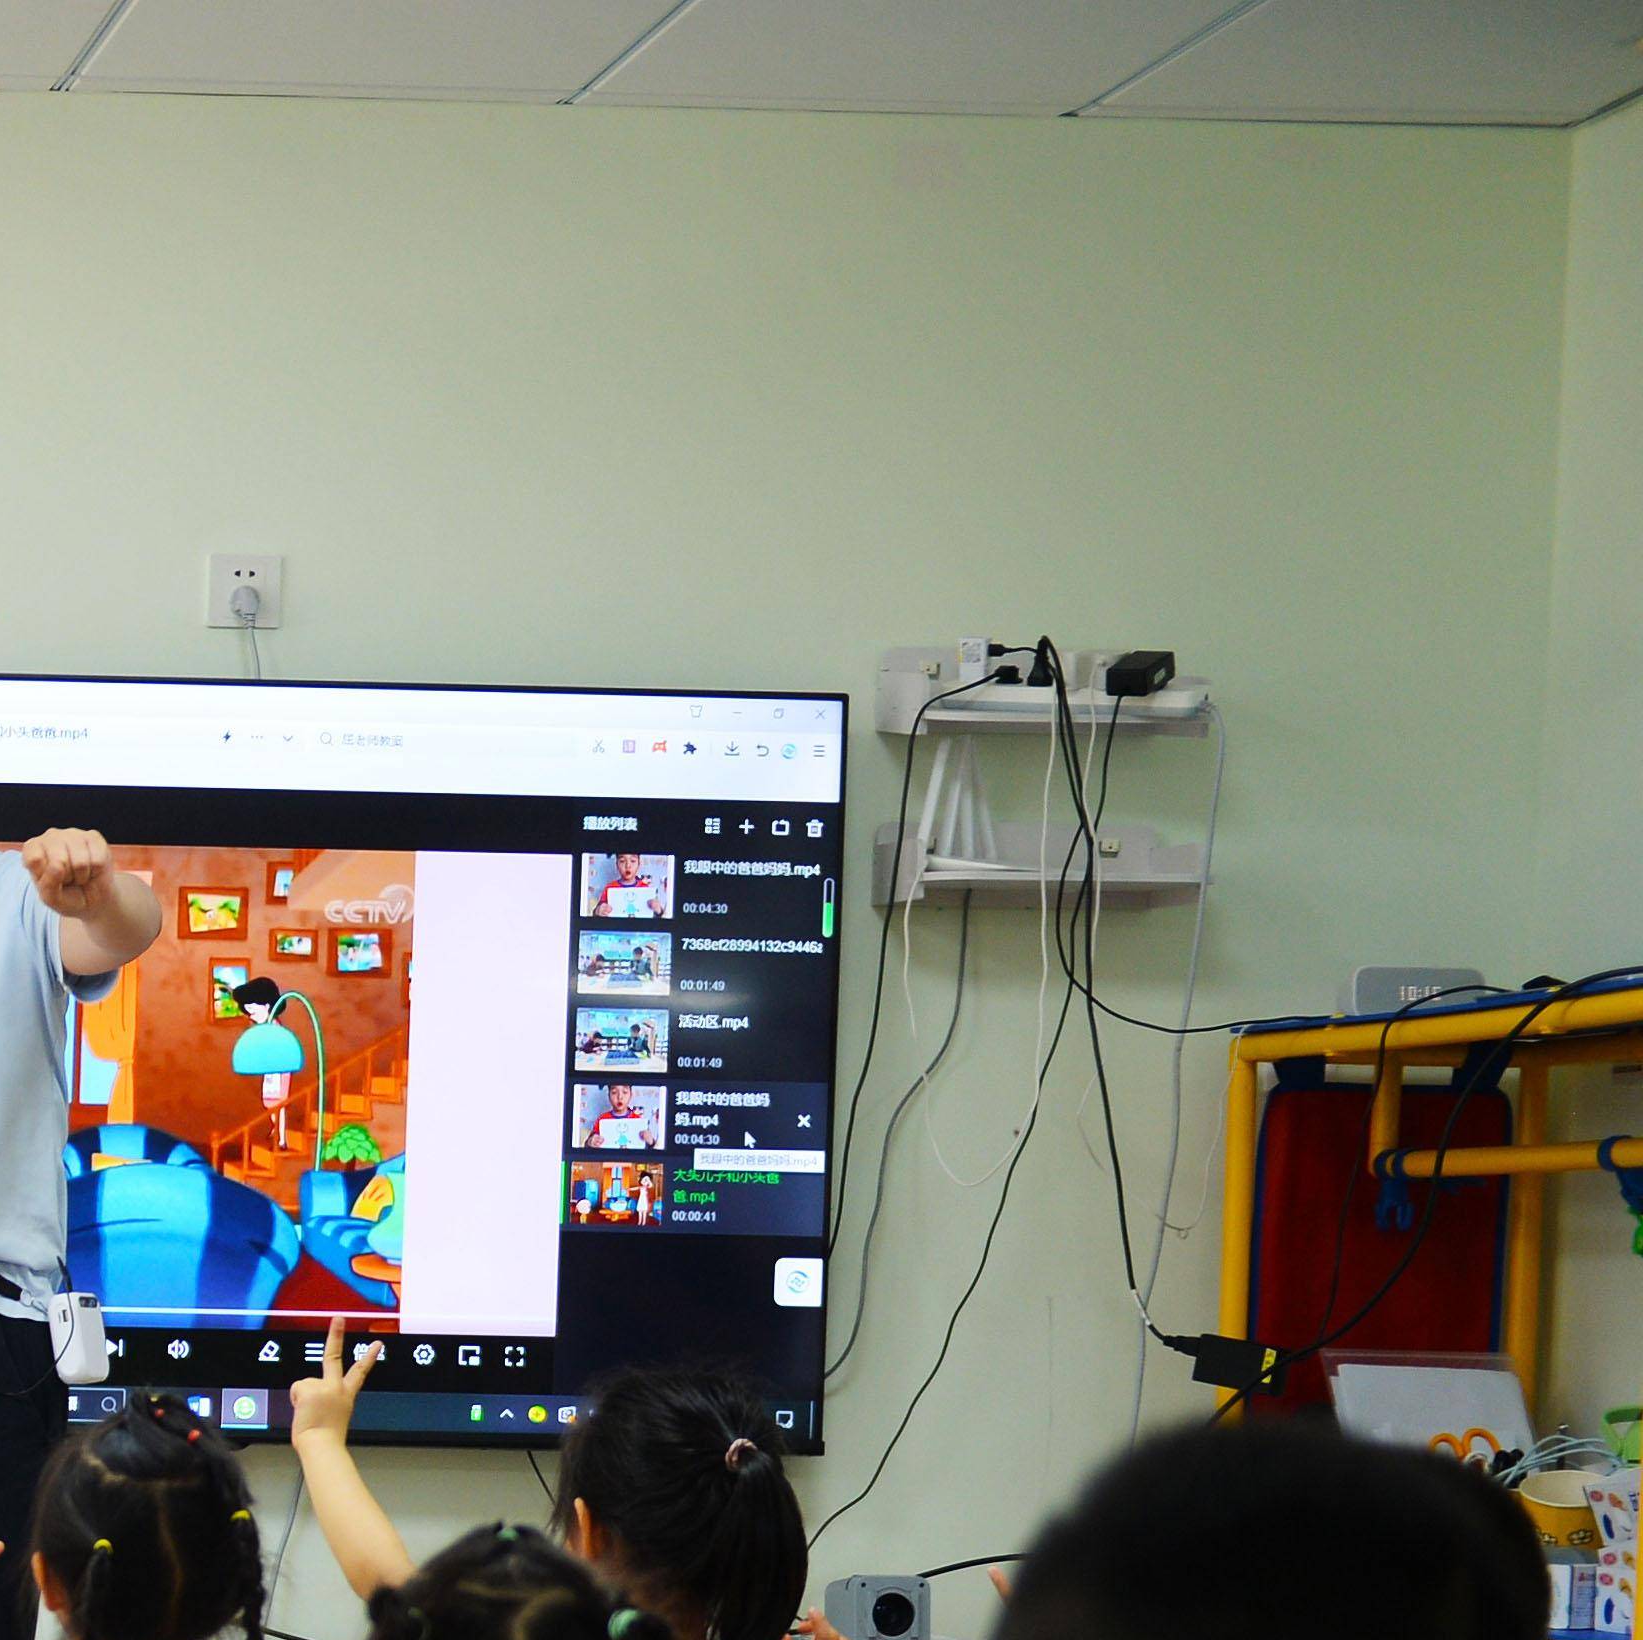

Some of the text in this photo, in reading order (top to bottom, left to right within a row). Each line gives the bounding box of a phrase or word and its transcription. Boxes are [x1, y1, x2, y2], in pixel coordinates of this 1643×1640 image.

[583, 816, 638, 831] 播放列表
[324, 899, 406, 924] CCTV
[682, 903, 728, 915] 00:04:30
[680, 980, 725, 991] 00:01:49
[677, 1057, 723, 1069] 00:01:49
[675, 1091, 771, 1108] 我眼中的爸爸妈
[674, 1112, 719, 1129] 妈.mp4
[674, 1134, 720, 1146] 00:04:30
[671, 1211, 717, 1223] 00:00:41
